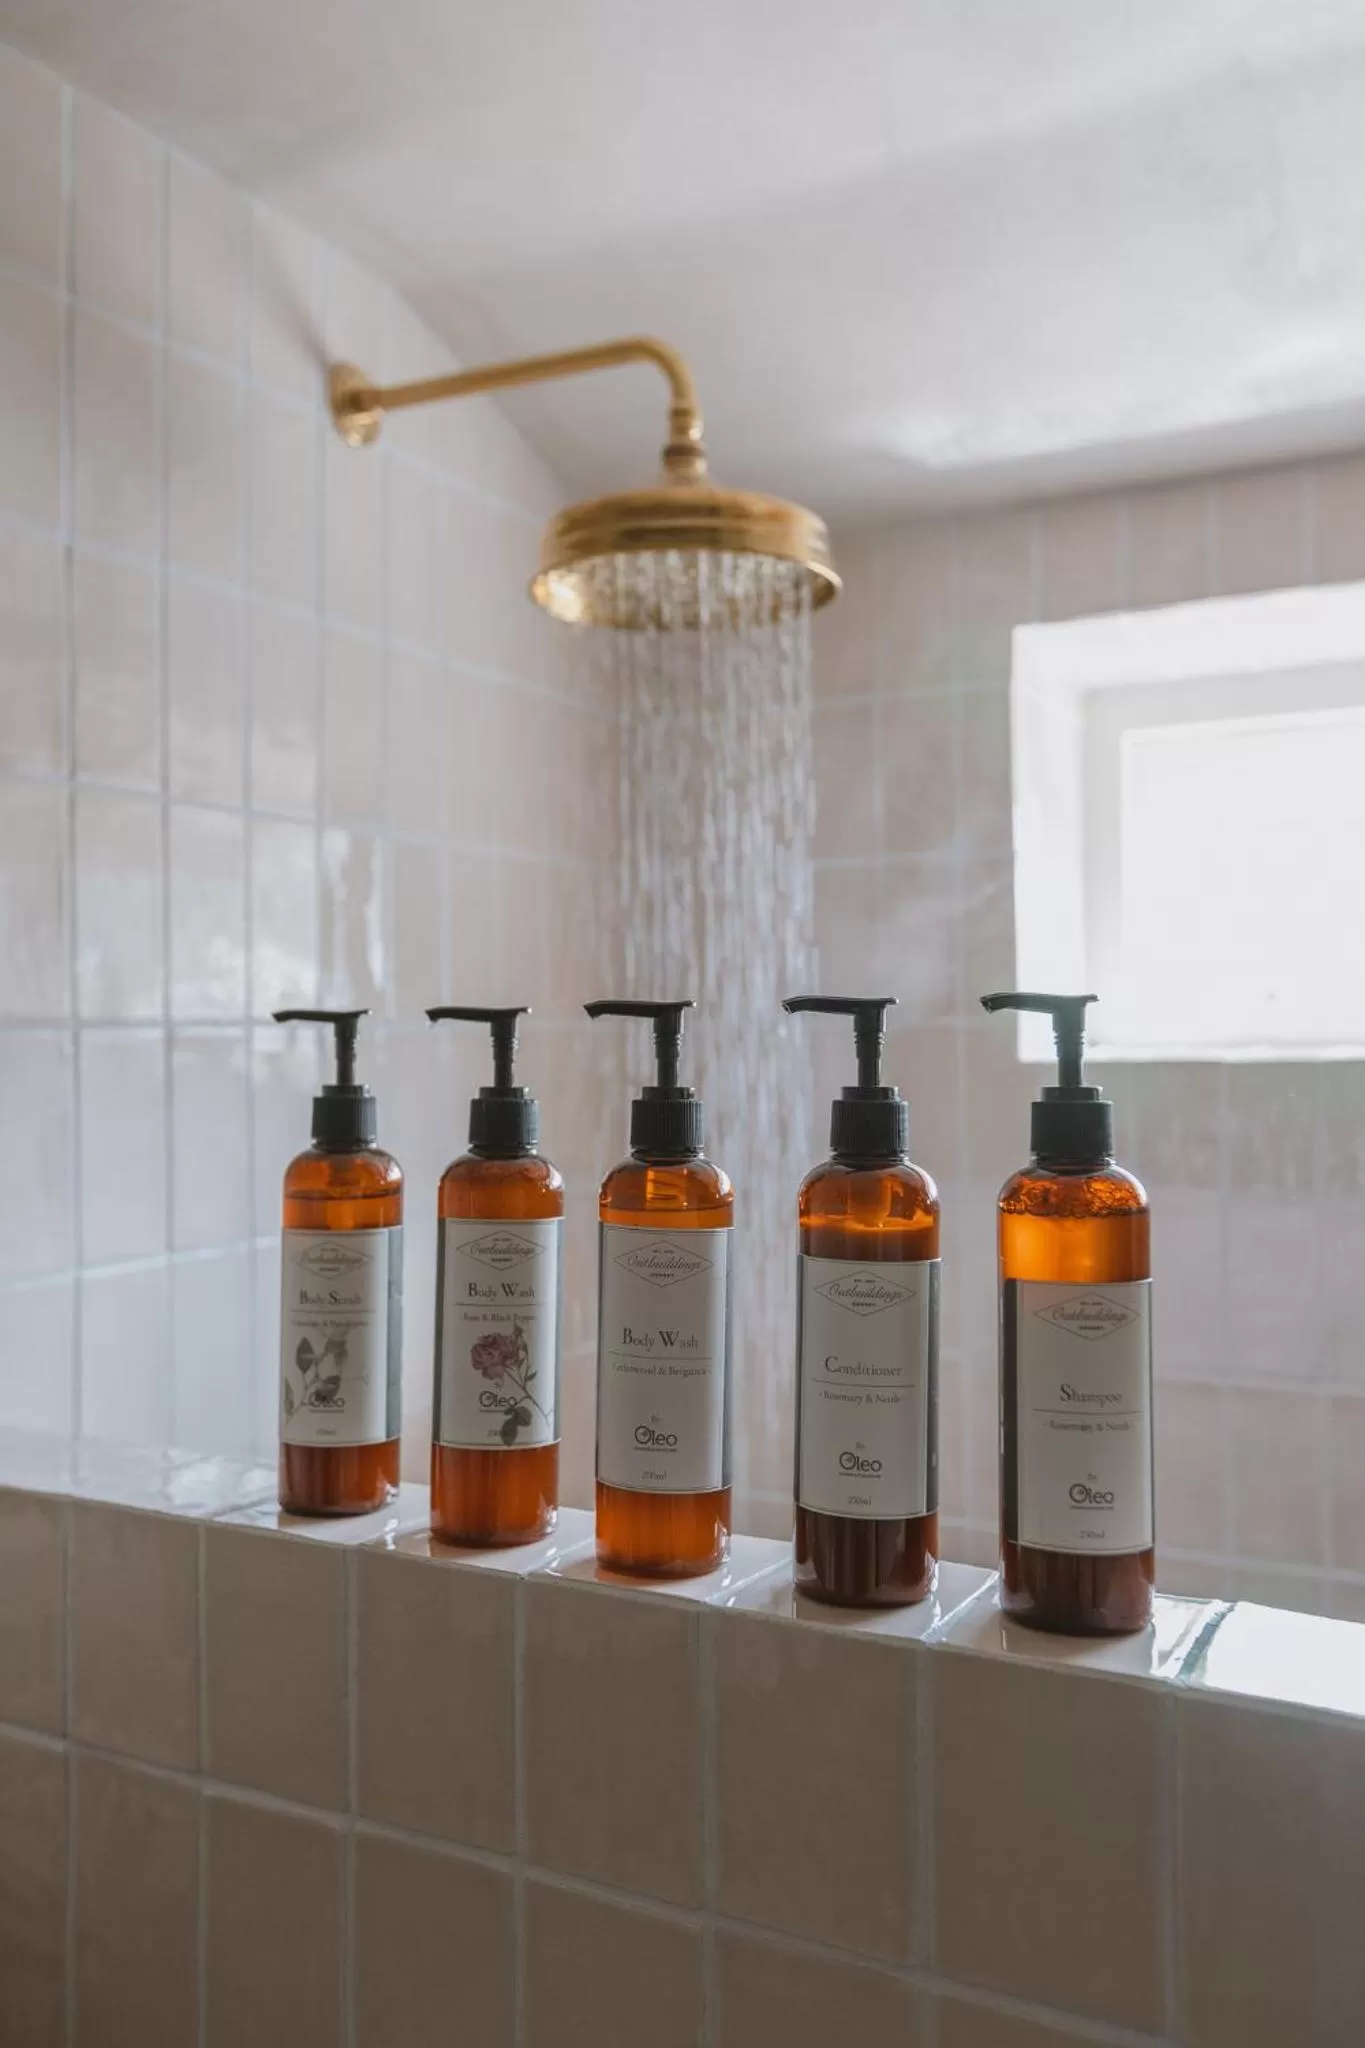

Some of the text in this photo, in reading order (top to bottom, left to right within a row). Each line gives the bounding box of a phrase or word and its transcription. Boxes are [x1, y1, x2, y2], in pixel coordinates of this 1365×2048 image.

[467, 1282, 536, 1302] Body Wash
[622, 1327, 699, 1352] Body Wash
[825, 1355, 902, 1377] Conditioner
[479, 1390, 518, 1408] Oleo
[1060, 1383, 1123, 1408] Shampoo
[634, 1425, 678, 1447] Oleo
[838, 1451, 883, 1472] Oleo
[1068, 1483, 1115, 1505] Oleo
